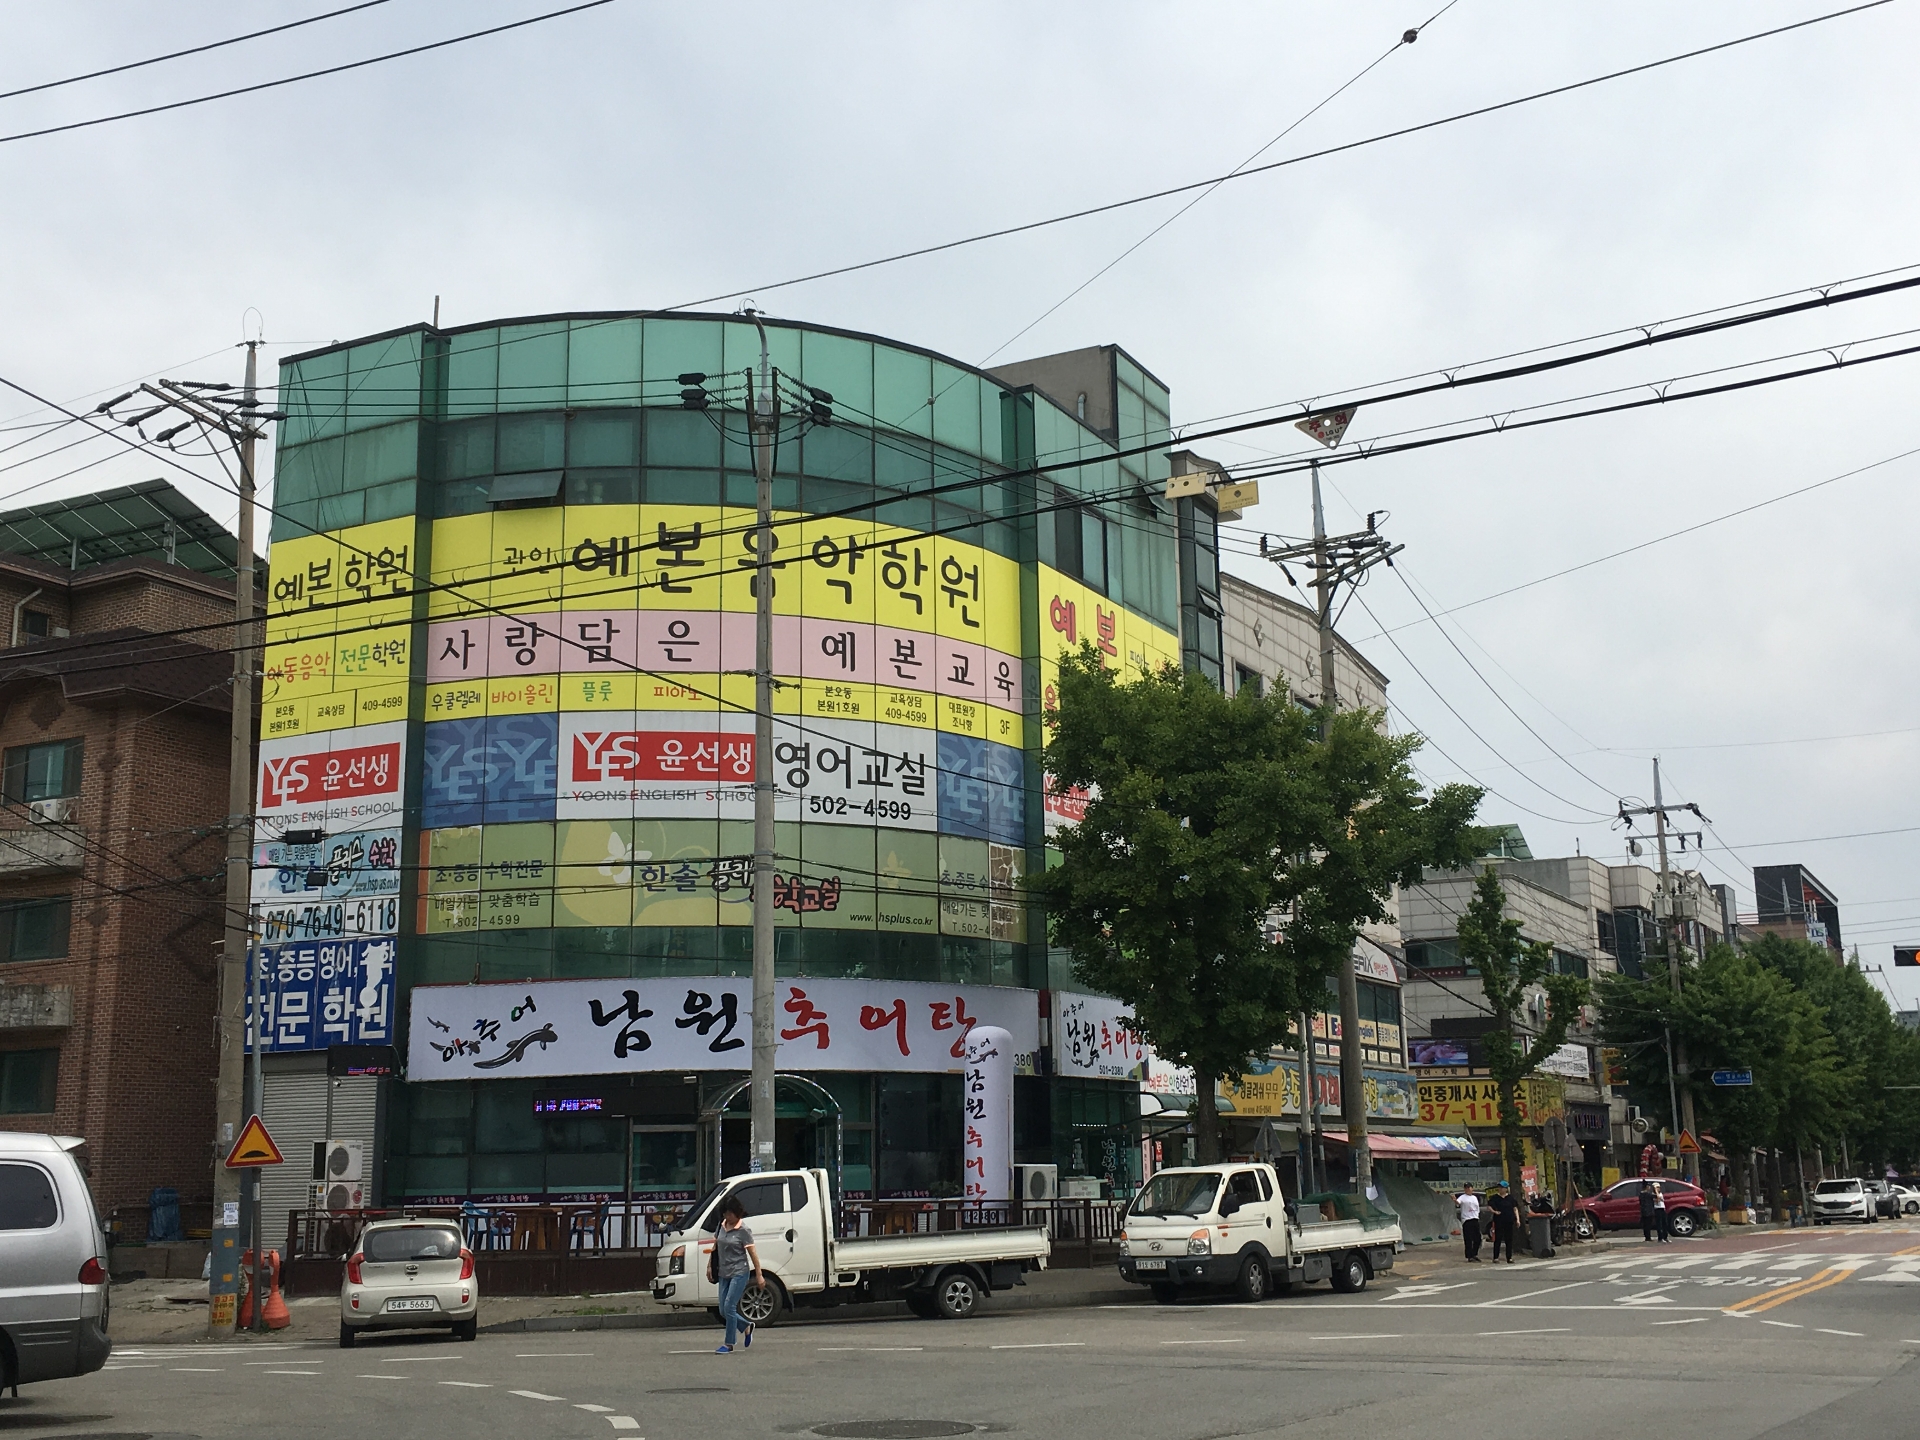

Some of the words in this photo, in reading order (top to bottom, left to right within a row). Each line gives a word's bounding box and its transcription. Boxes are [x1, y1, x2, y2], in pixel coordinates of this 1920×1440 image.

[502, 546, 551, 574] 관인
[571, 521, 980, 629] 예본음악학원
[431, 690, 481, 711] 우쿨렐레
[491, 683, 553, 706] 바이올린
[582, 680, 613, 703] 플룻
[653, 684, 703, 701] 피아노
[824, 685, 853, 700] 본오동
[890, 693, 923, 708] 교육상담
[276, 705, 295, 718] 본오동
[317, 704, 346, 718] 교육상담
[362, 696, 403, 711] 409-4599
[817, 699, 860, 715] 본원1호원
[948, 702, 976, 719] 대표원장
[885, 707, 928, 724] 409-4599
[999, 719, 1011, 735] 3F
[655, 738, 753, 776] 윤선생
[321, 753, 390, 792] 윤선생
[774, 741, 927, 797] 영어교실
[572, 790, 627, 802] YOONS
[630, 788, 697, 801] ENGLISH
[301, 807, 350, 824] ENGLISH
[351, 801, 397, 818] SCHOOL
[809, 796, 912, 821] 502-4599
[639, 864, 701, 893] 한솔
[588, 988, 746, 1059] 남원
[780, 986, 978, 1059] 추어탕
[1098, 1064, 1124, 1076] 501-2380
[965, 1068, 987, 1120] 남원
[1482, 1084, 1527, 1102] 사소
[965, 1125, 988, 1208] 추어탕
[409, 1300, 430, 1309] 5663
